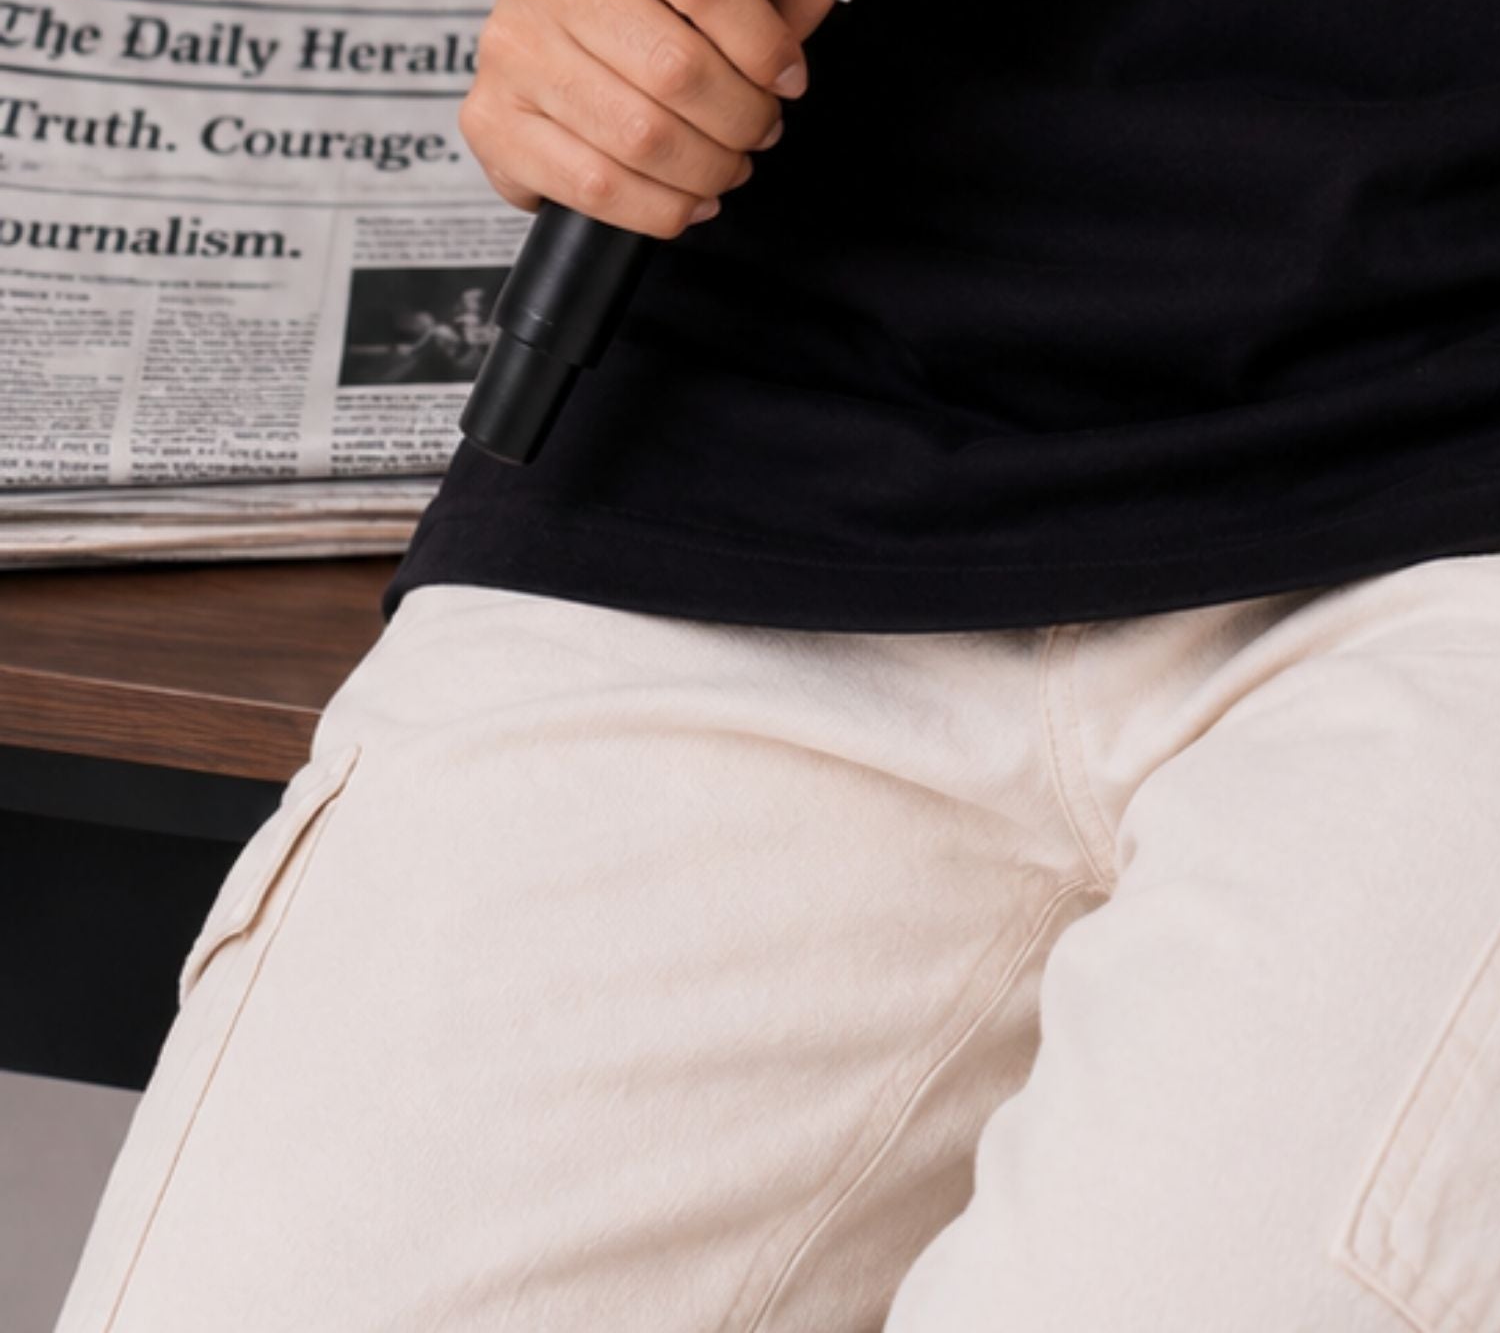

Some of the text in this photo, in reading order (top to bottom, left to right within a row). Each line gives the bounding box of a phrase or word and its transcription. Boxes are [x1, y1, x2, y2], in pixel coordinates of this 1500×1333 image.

[0, 0, 103, 61] The
[119, 13, 280, 79] Daily
[0, 96, 461, 172] Truth. Courage.
